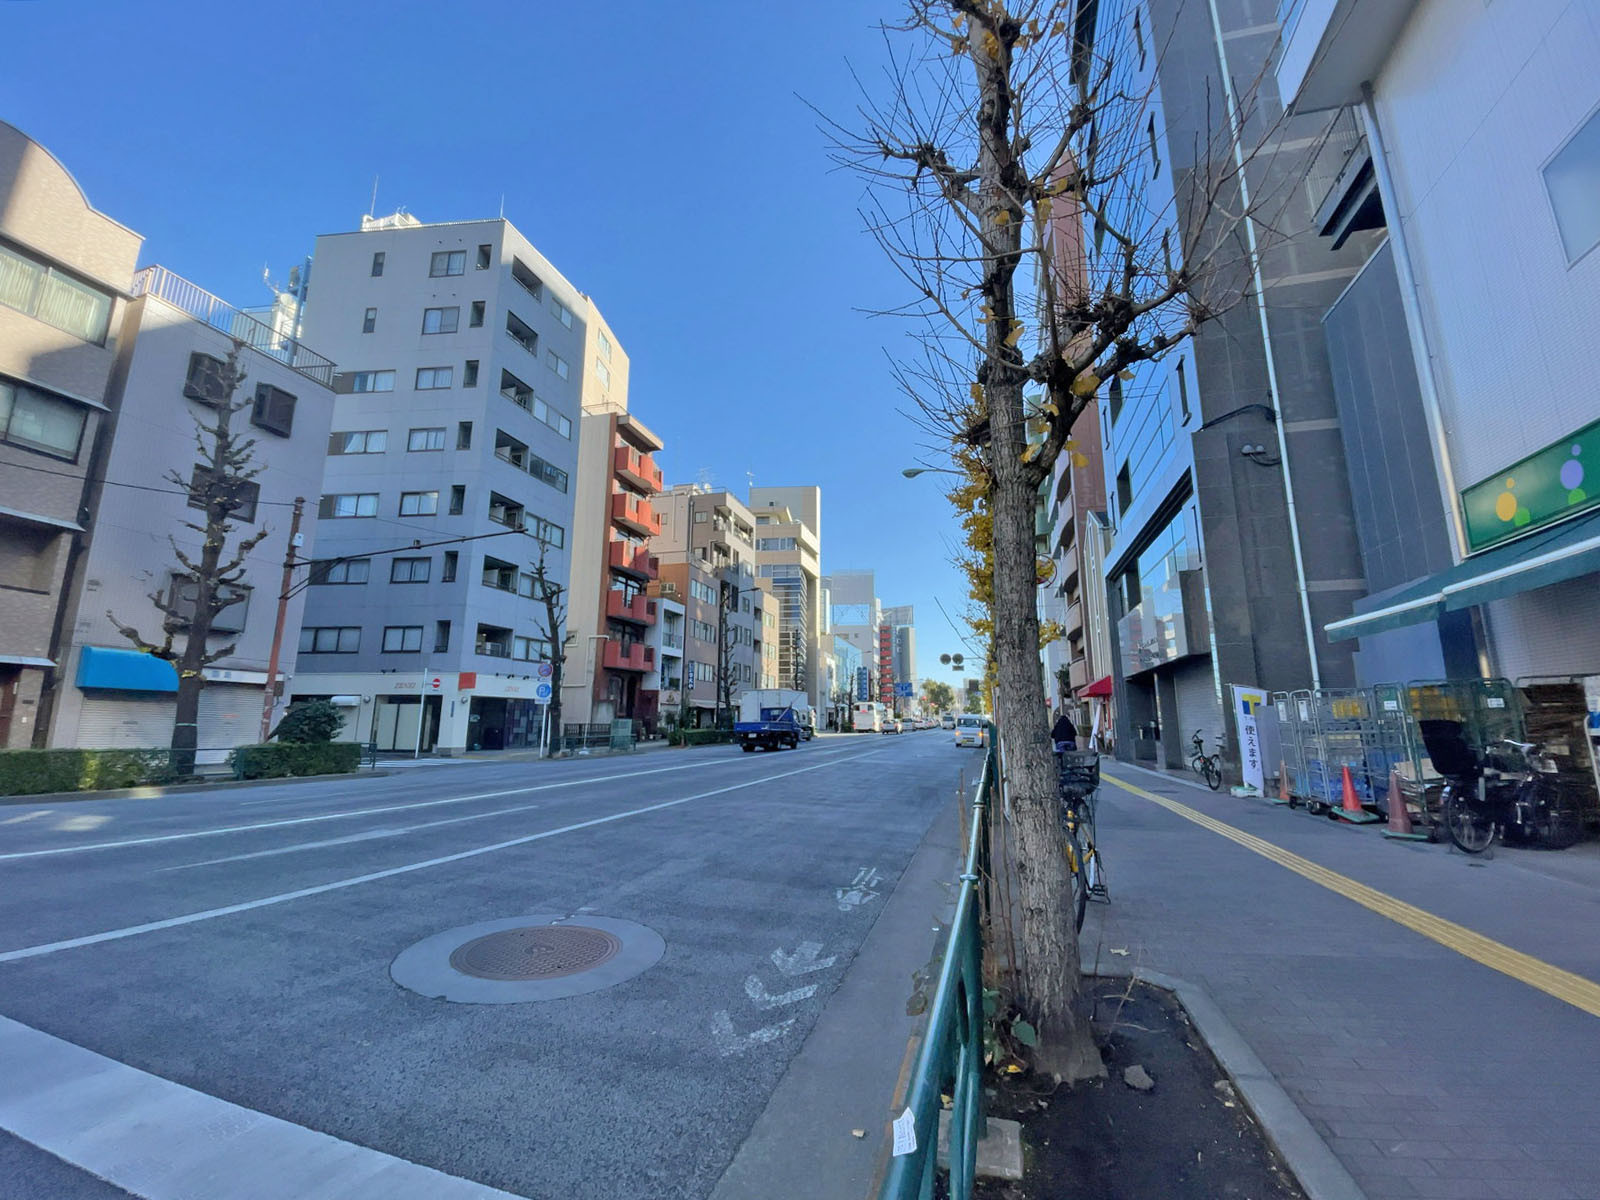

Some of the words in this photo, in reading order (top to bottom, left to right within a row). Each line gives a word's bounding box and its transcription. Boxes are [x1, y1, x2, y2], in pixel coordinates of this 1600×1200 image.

[1242, 694, 1261, 715] T
[1245, 725, 1258, 769] 使えます
